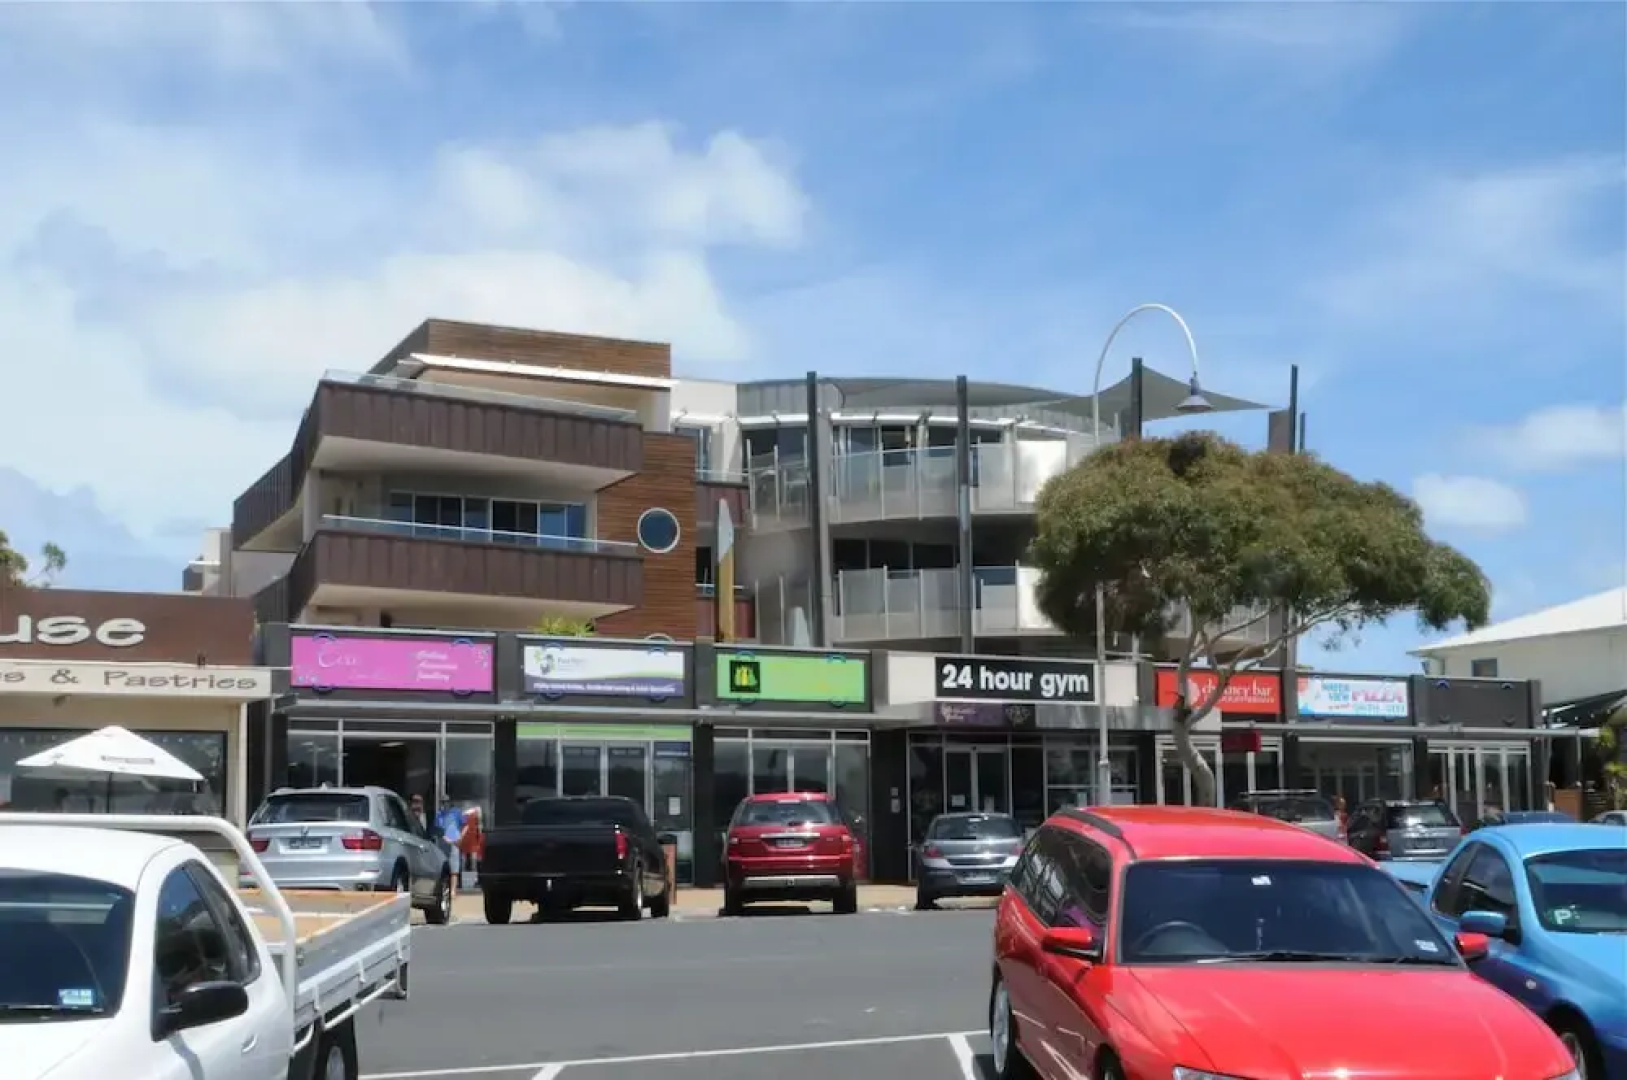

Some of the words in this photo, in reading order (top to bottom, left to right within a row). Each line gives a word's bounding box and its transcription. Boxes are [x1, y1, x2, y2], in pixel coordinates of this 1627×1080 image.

[50, 669, 81, 684] &
[104, 671, 257, 689] Pastries
[942, 664, 973, 689] 24
[980, 665, 1033, 691] hour
[1040, 672, 1089, 698] gym
[1553, 909, 1571, 925] P
